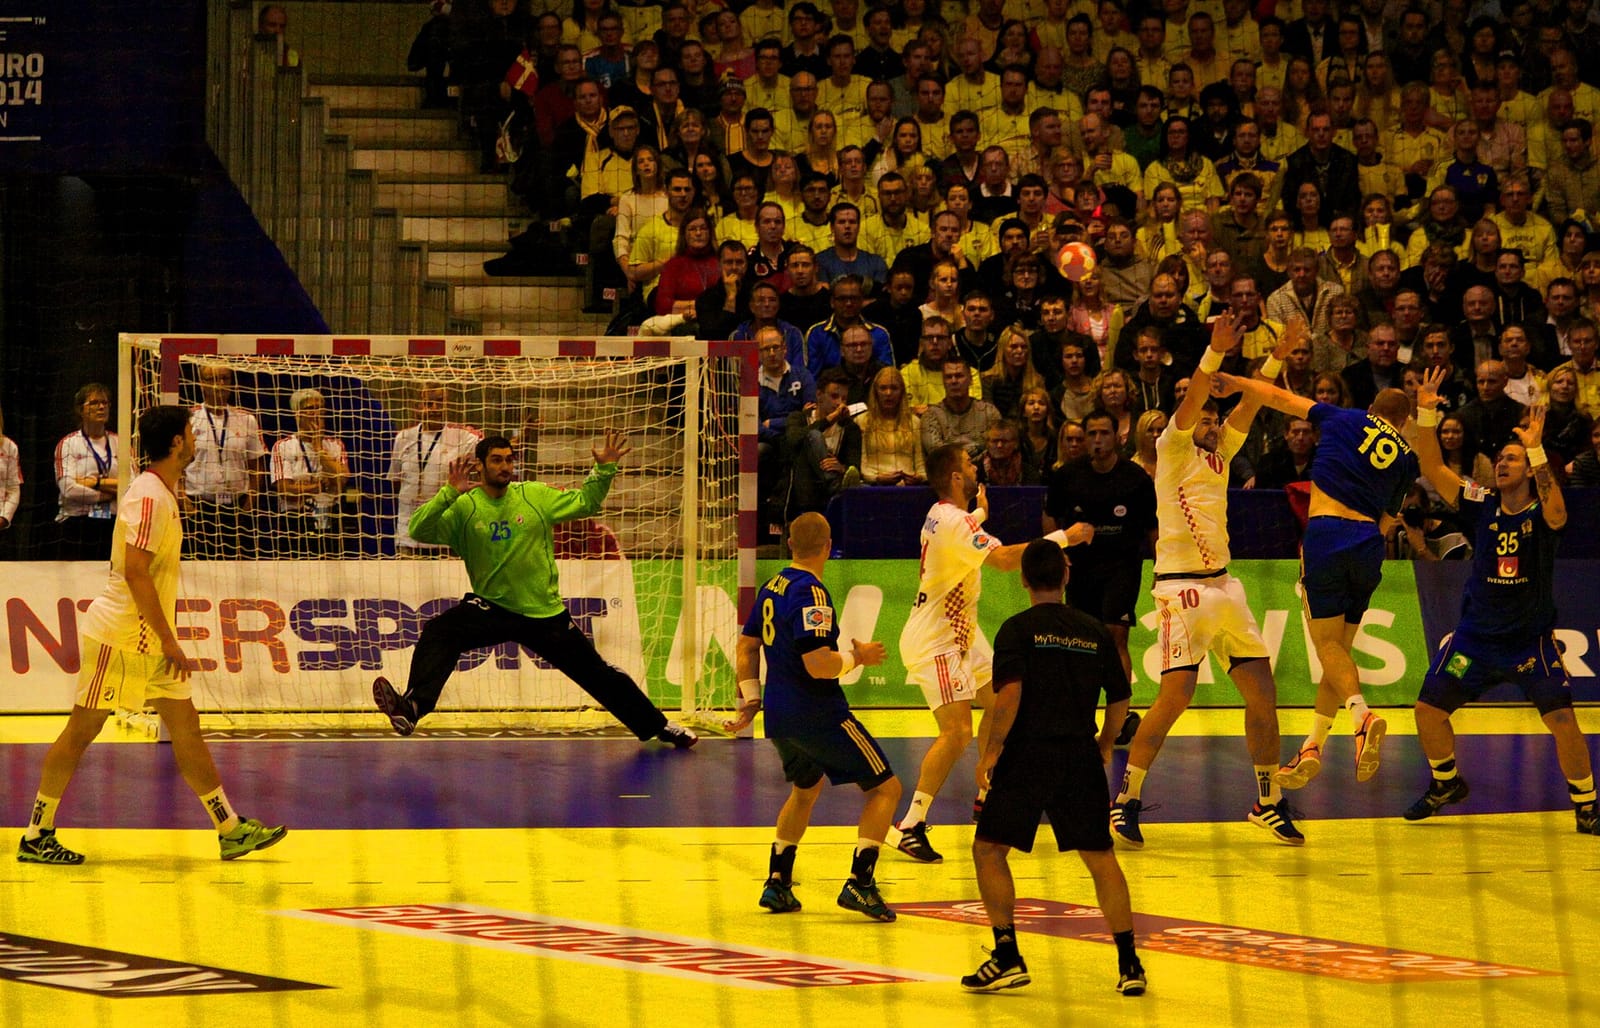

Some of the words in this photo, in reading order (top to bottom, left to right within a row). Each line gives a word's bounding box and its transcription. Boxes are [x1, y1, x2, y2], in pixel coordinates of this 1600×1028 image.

[0, 53, 44, 78] RO
[1358, 426, 1398, 469] 19
[489, 521, 512, 542] 25
[1496, 532, 1519, 555] 35
[1487, 577, 1514, 585] SVENSKA
[1515, 576, 1529, 585] SPEL
[1178, 588, 1200, 610] 10
[762, 597, 775, 646] 8
